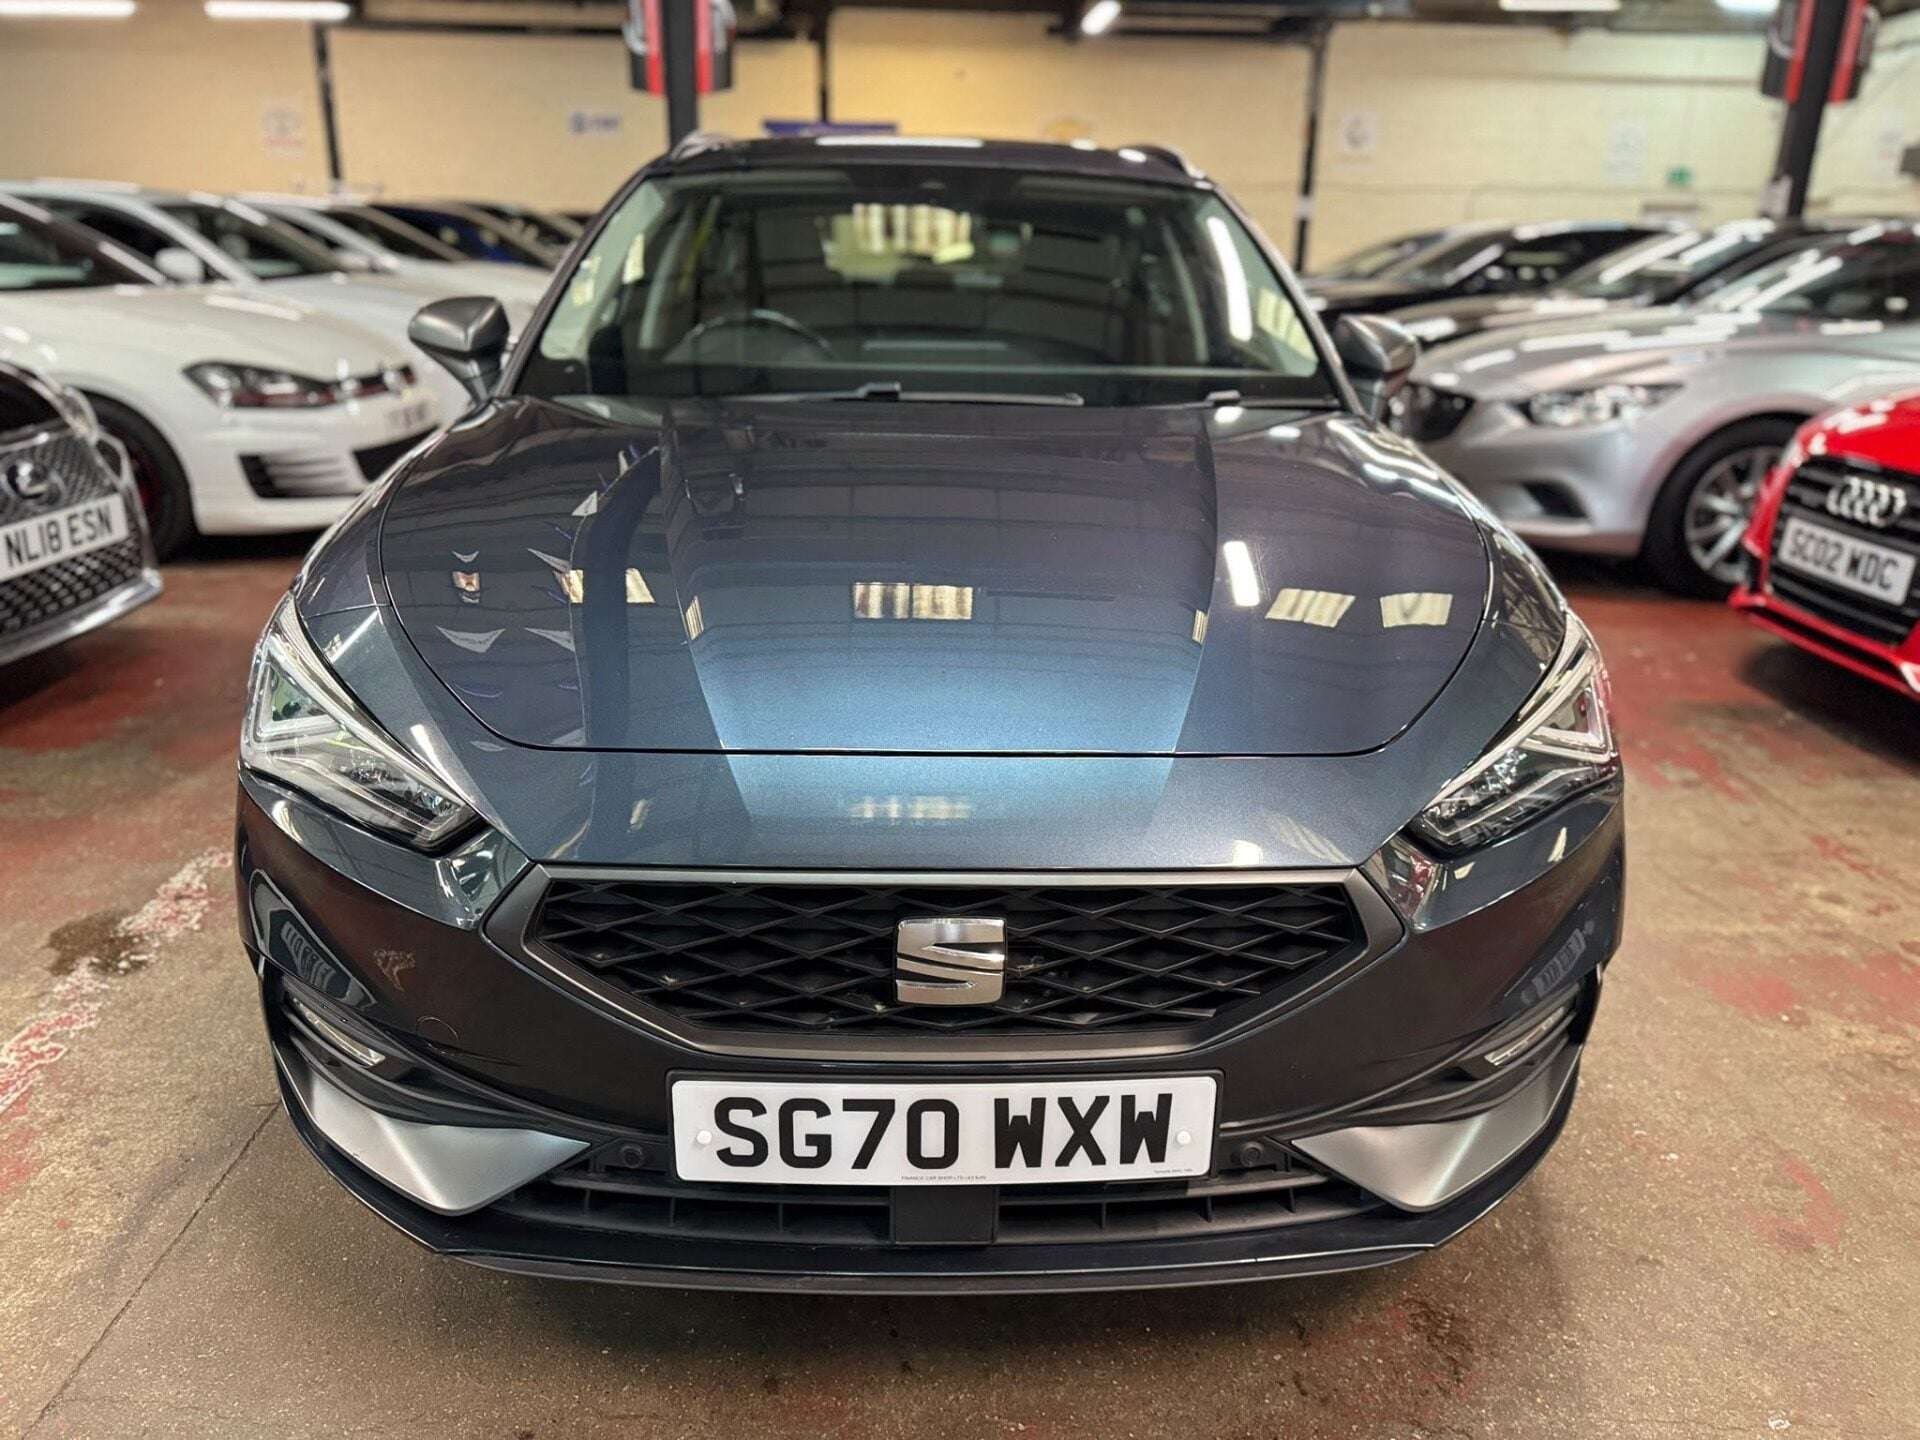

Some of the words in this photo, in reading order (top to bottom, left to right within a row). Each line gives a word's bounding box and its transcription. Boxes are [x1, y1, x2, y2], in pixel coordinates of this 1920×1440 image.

[4, 519, 63, 567] NL18
[66, 504, 113, 547] ESN
[714, 1096, 960, 1170] SG70
[993, 1093, 1173, 1169] WXW
